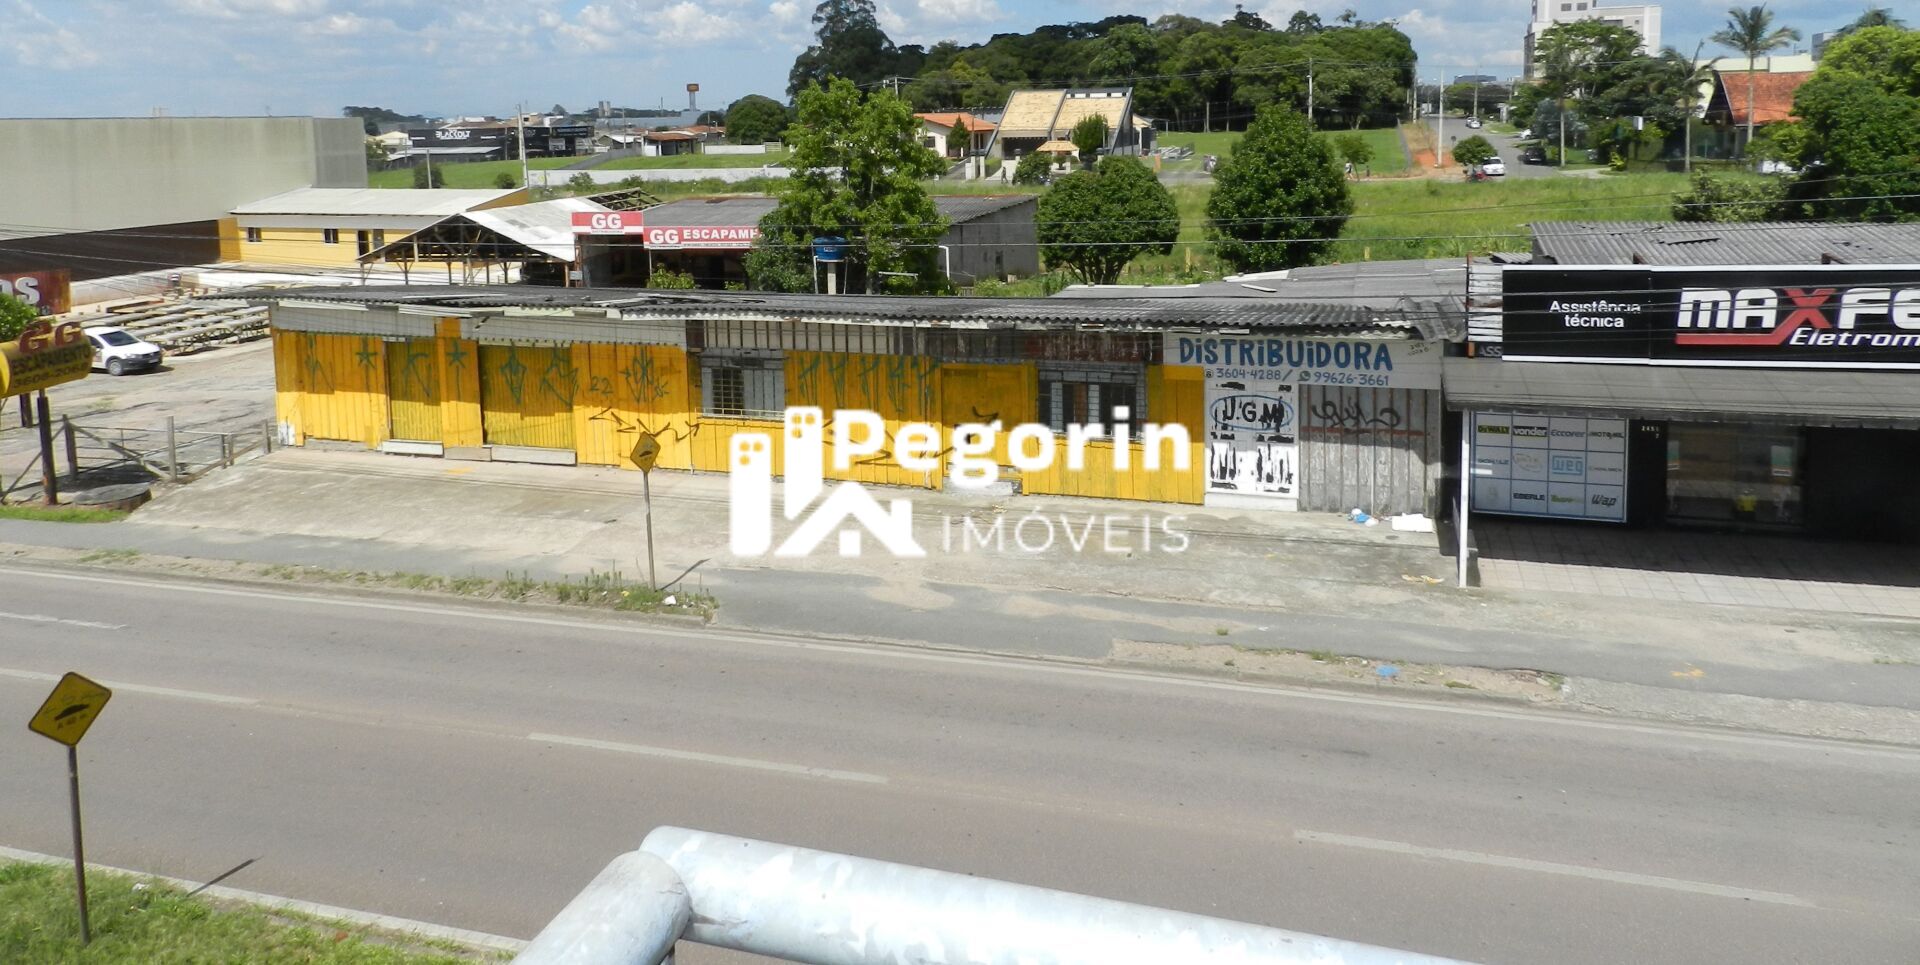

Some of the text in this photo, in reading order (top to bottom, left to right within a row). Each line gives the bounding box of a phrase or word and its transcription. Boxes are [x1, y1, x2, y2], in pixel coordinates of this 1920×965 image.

[591, 213, 622, 229] GG
[649, 229, 679, 244] GG
[1549, 300, 1641, 314] Assistência
[1565, 314, 1625, 328] técnica
[19, 319, 82, 353] GG
[1313, 371, 1389, 386] 99626-3661
